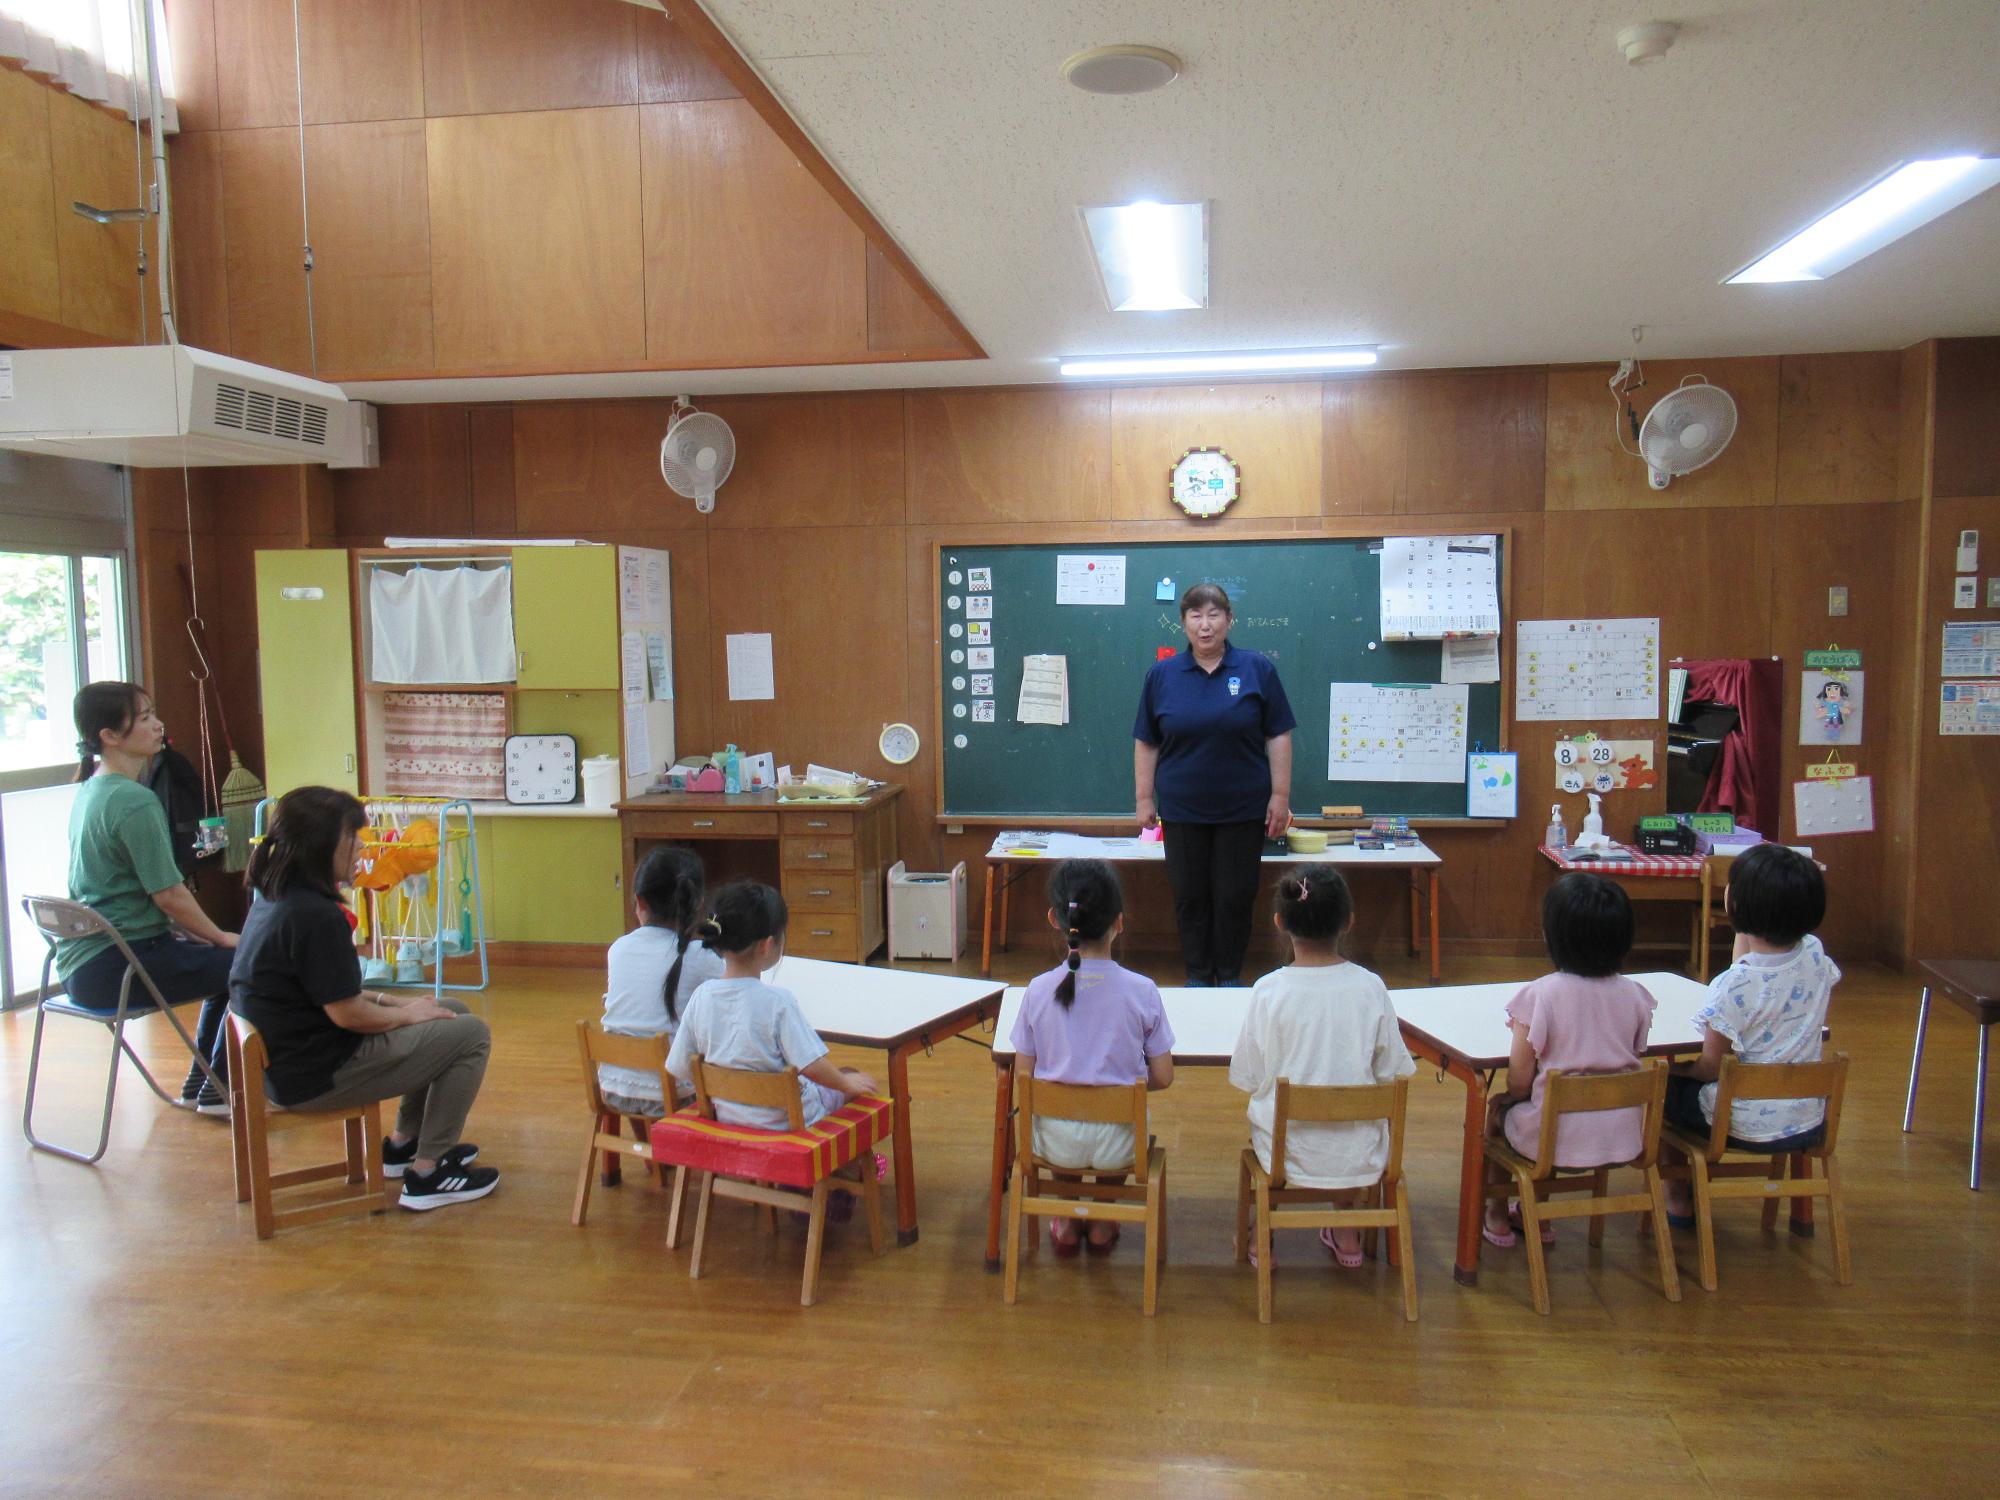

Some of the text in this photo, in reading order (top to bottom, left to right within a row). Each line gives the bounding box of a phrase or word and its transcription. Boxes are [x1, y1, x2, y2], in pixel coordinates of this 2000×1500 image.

[1561, 748, 1609, 764] 8 28
[1814, 765, 1850, 776] なふだ
[1565, 780, 1580, 788] きん
